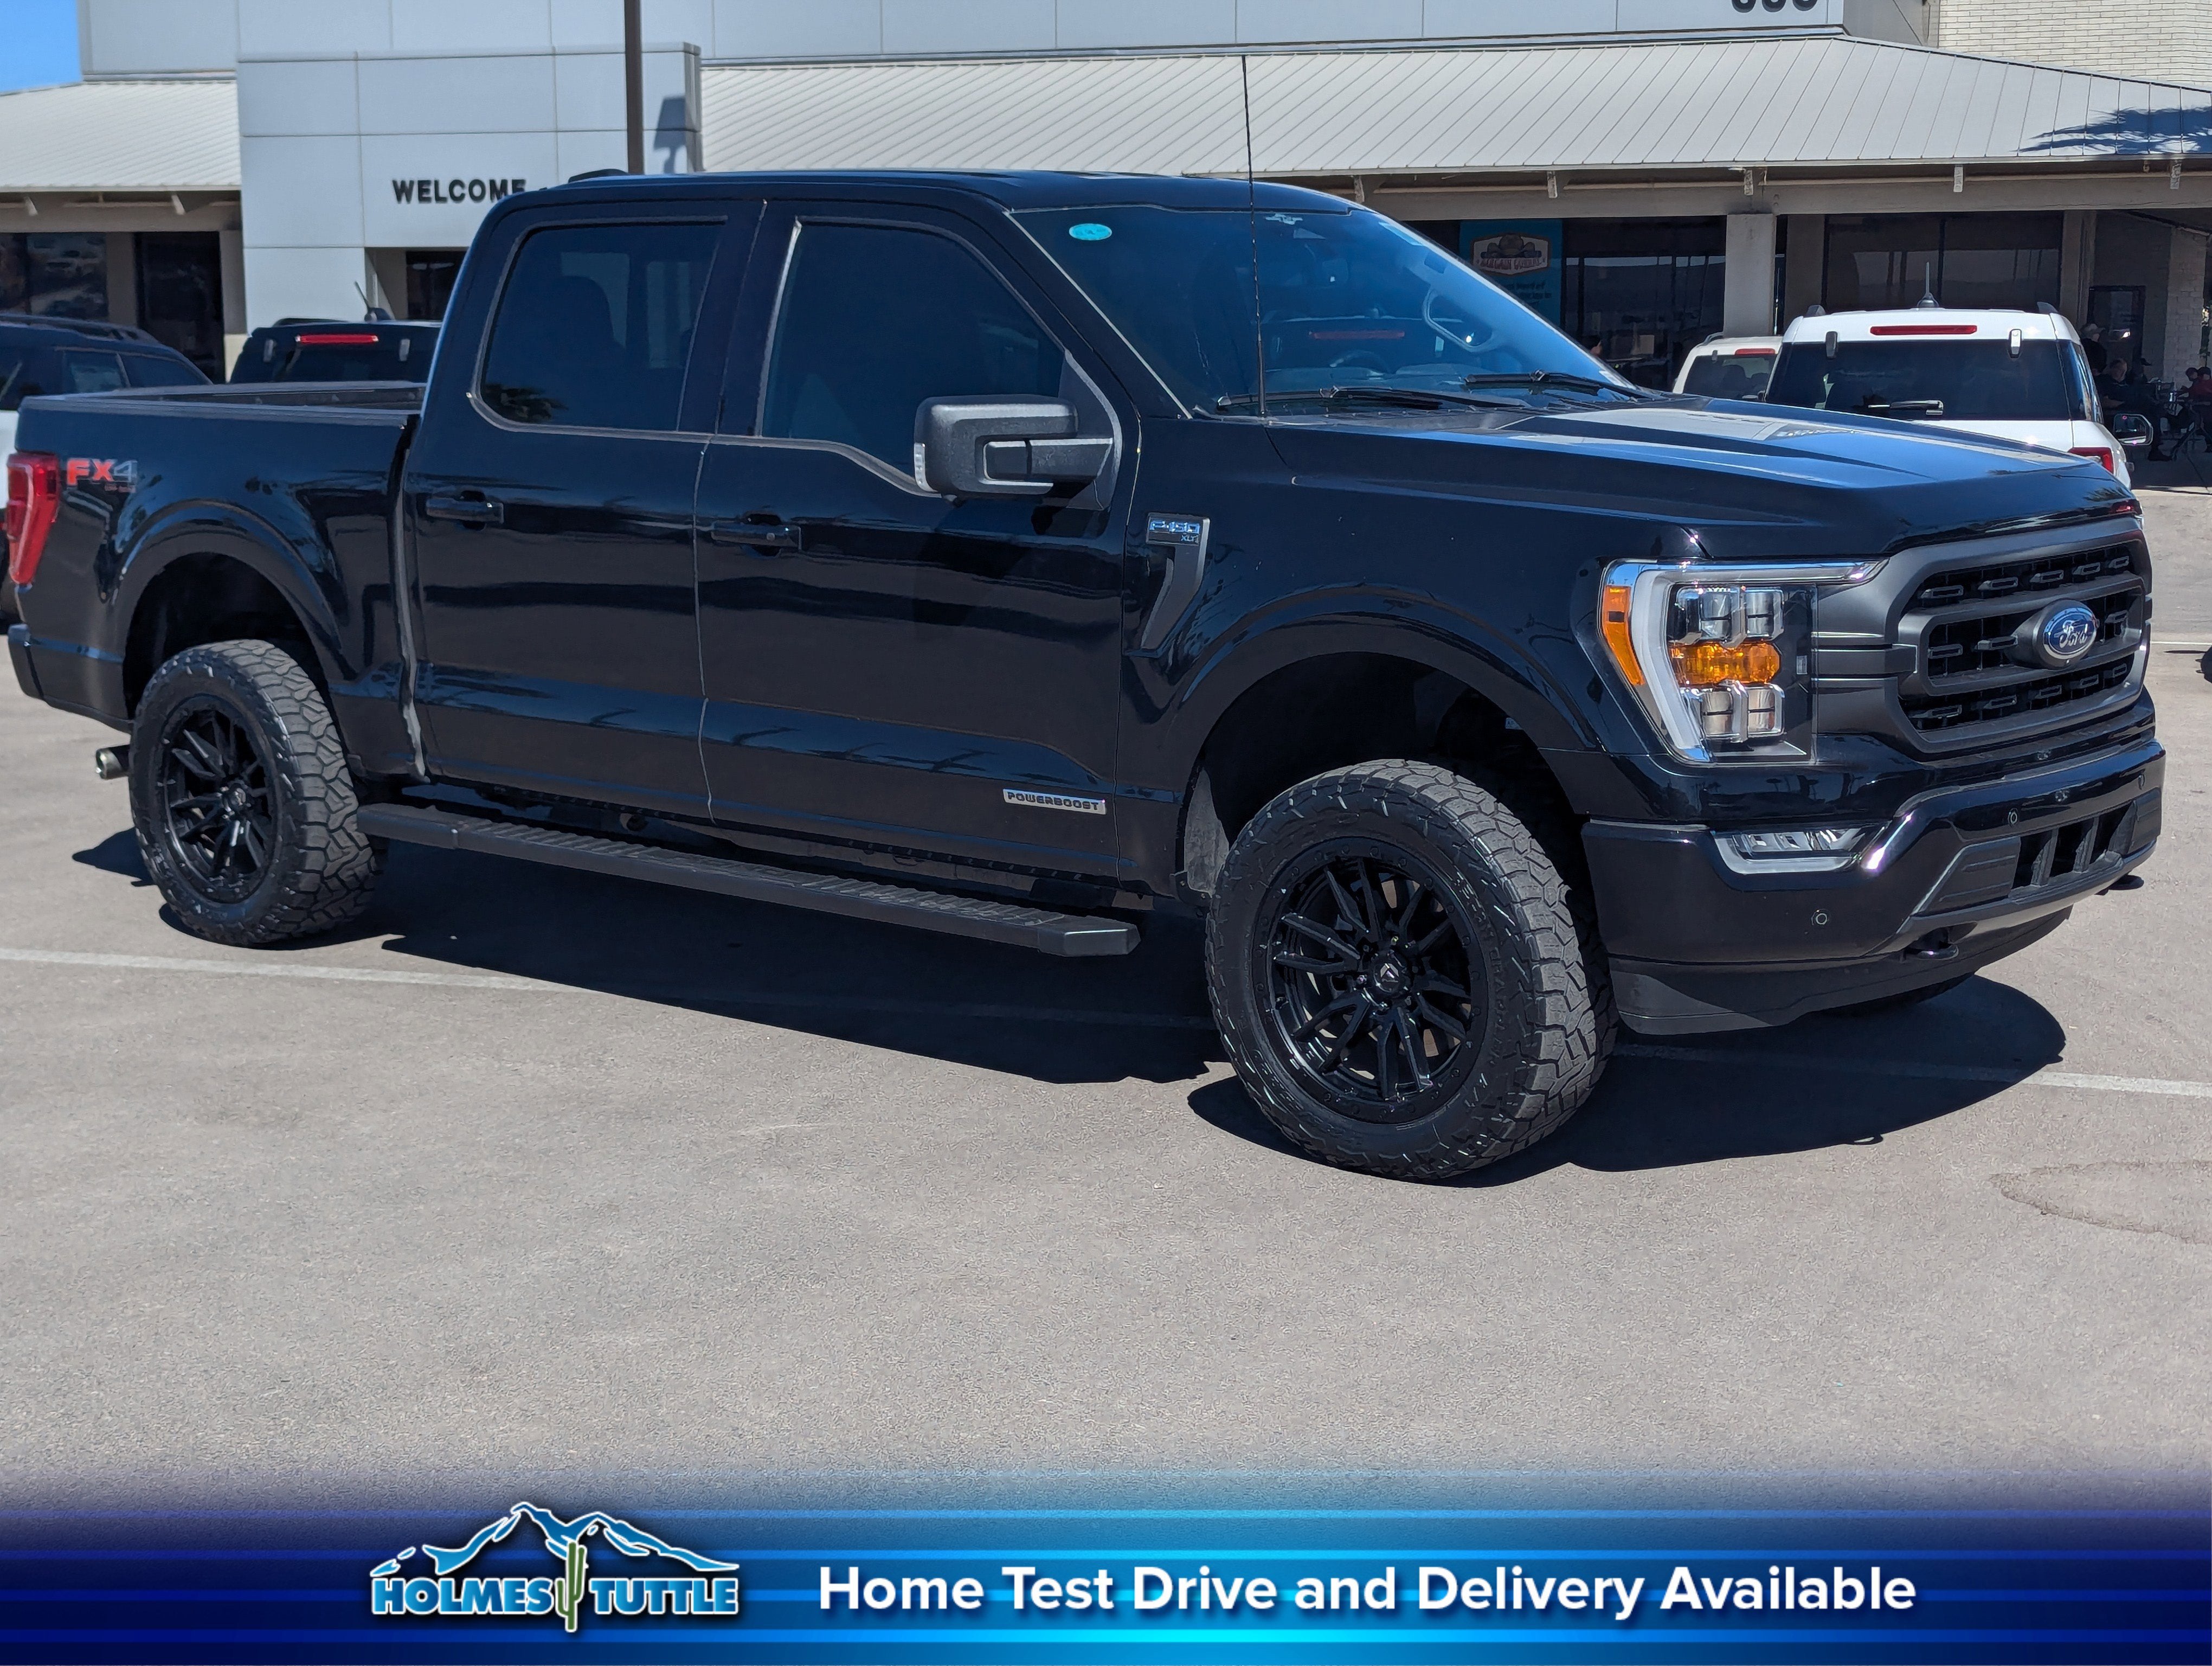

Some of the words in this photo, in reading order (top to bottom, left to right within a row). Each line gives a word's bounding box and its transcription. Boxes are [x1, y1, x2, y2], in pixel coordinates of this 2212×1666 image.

[391, 178, 526, 204] WELCOME
[66, 458, 138, 486] FX4
[2054, 619, 2088, 649] Ford
[1007, 791, 1099, 811] POWERBOOST
